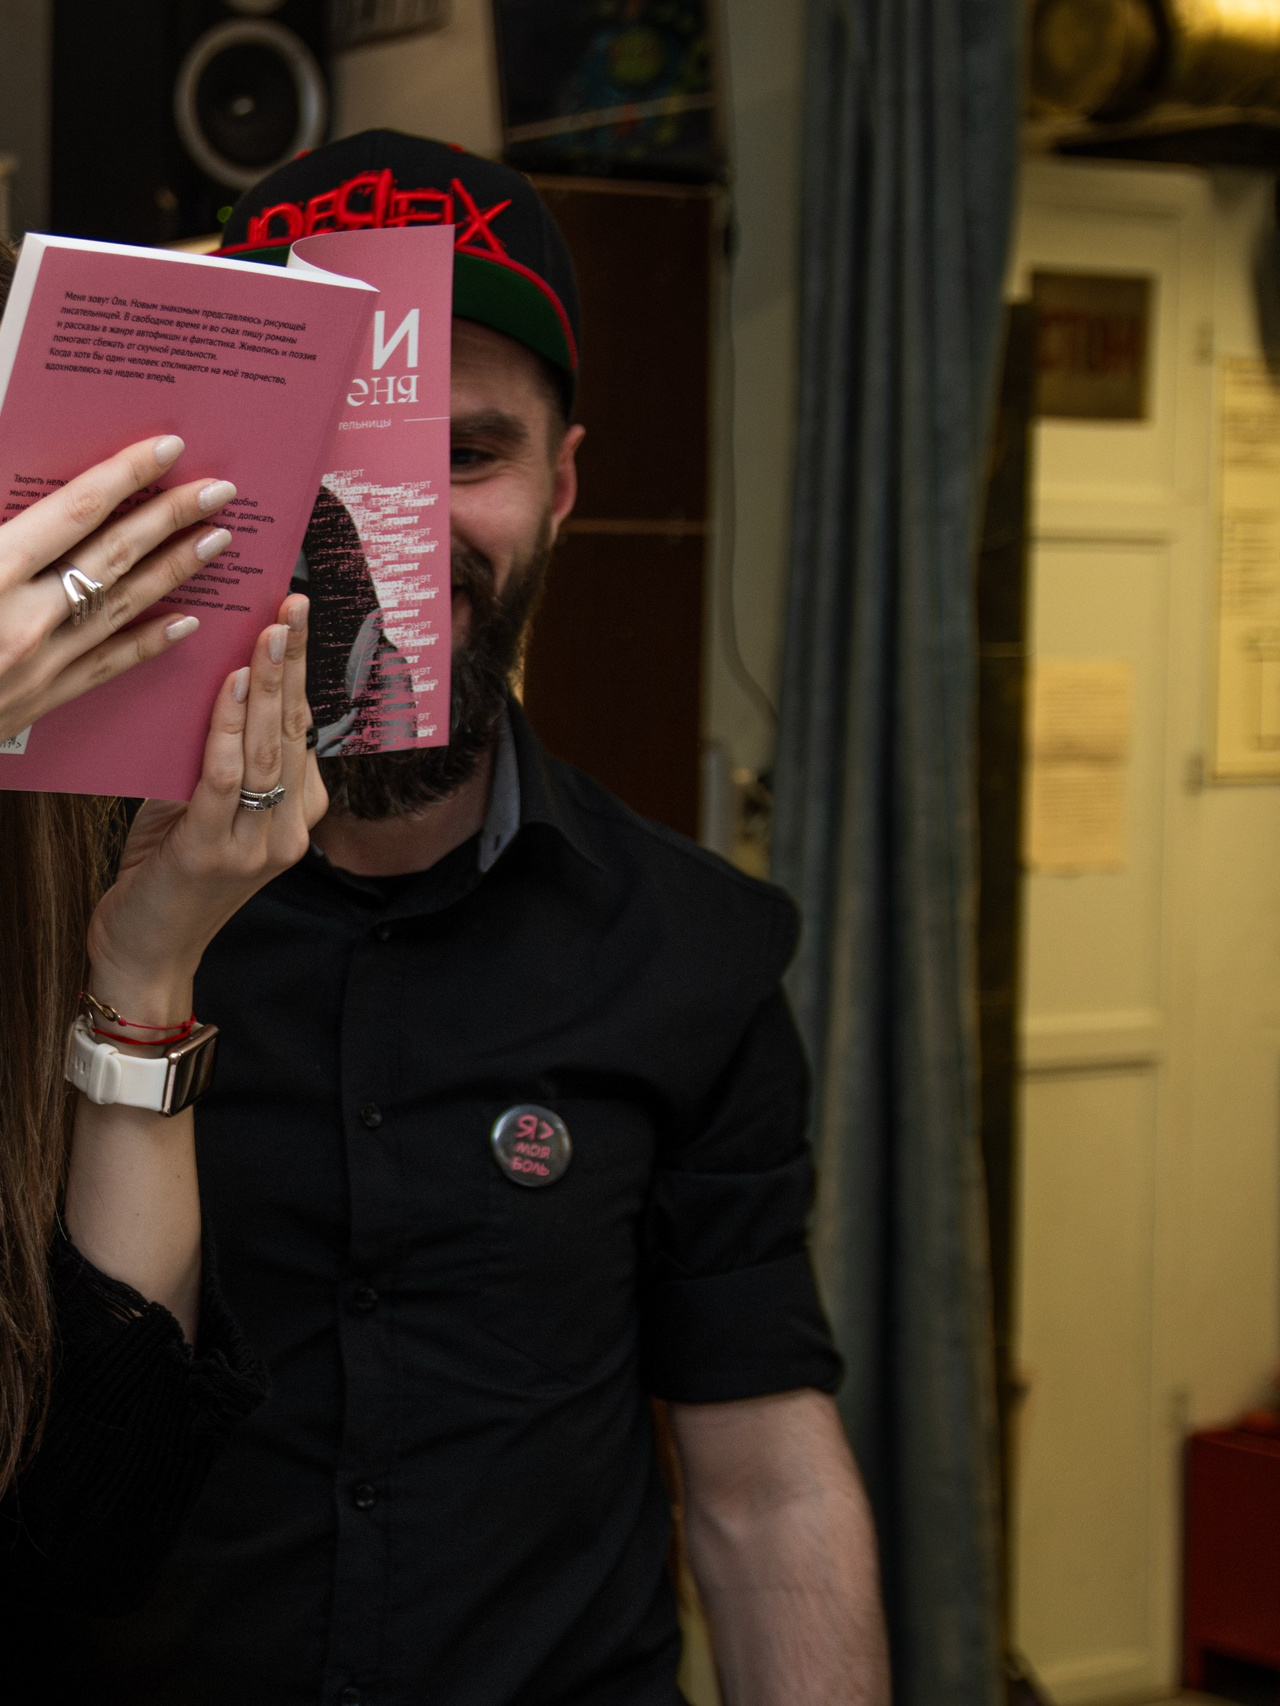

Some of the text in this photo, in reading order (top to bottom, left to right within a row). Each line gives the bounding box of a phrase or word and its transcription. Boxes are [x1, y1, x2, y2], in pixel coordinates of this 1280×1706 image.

[65, 291, 306, 332] Меня зовут Оля. Новым знакомым представляюсь рисующей
[61, 307, 121, 320] писательницей.
[124, 312, 130, 321] В
[132, 315, 174, 326] свободное
[176, 320, 201, 330] время
[209, 324, 219, 332] во
[221, 326, 240, 335] снах
[242, 330, 264, 341] пишу
[265, 333, 297, 344] романы
[53, 334, 91, 345] помогают
[93, 337, 124, 349] сбежать
[137, 343, 169, 354] скучной
[170, 347, 217, 360] реальности.
[64, 321, 99, 331] рассказы
[102, 325, 107, 333] в
[109, 327, 134, 336] жанре
[136, 329, 180, 341] автофикшн
[190, 335, 236, 349] фантастика.
[239, 341, 280, 356] Живопись
[289, 351, 317, 361] поэзия
[372, 308, 420, 370] И
[45, 362, 101, 375] вдохновляюсь
[104, 368, 113, 376] на
[115, 370, 144, 379] неделю
[50, 347, 71, 358] Когда
[74, 350, 90, 358] хотя
[93, 351, 104, 360] бы
[106, 353, 125, 363] один
[128, 356, 159, 367] человек
[161, 359, 209, 373] откликается
[223, 368, 238, 377] моё
[241, 371, 286, 385] творчество,
[14, 474, 44, 486] Творить
[9, 490, 40, 498] мыслям
[221, 508, 236, 518] Как
[238, 512, 275, 523] дописать
[237, 526, 258, 534] имён
[191, 573, 240, 585] растинация
[228, 563, 263, 576] Синдром
[179, 585, 220, 596] создавать.
[184, 597, 223, 609] любимым
[225, 604, 252, 613] делом.
